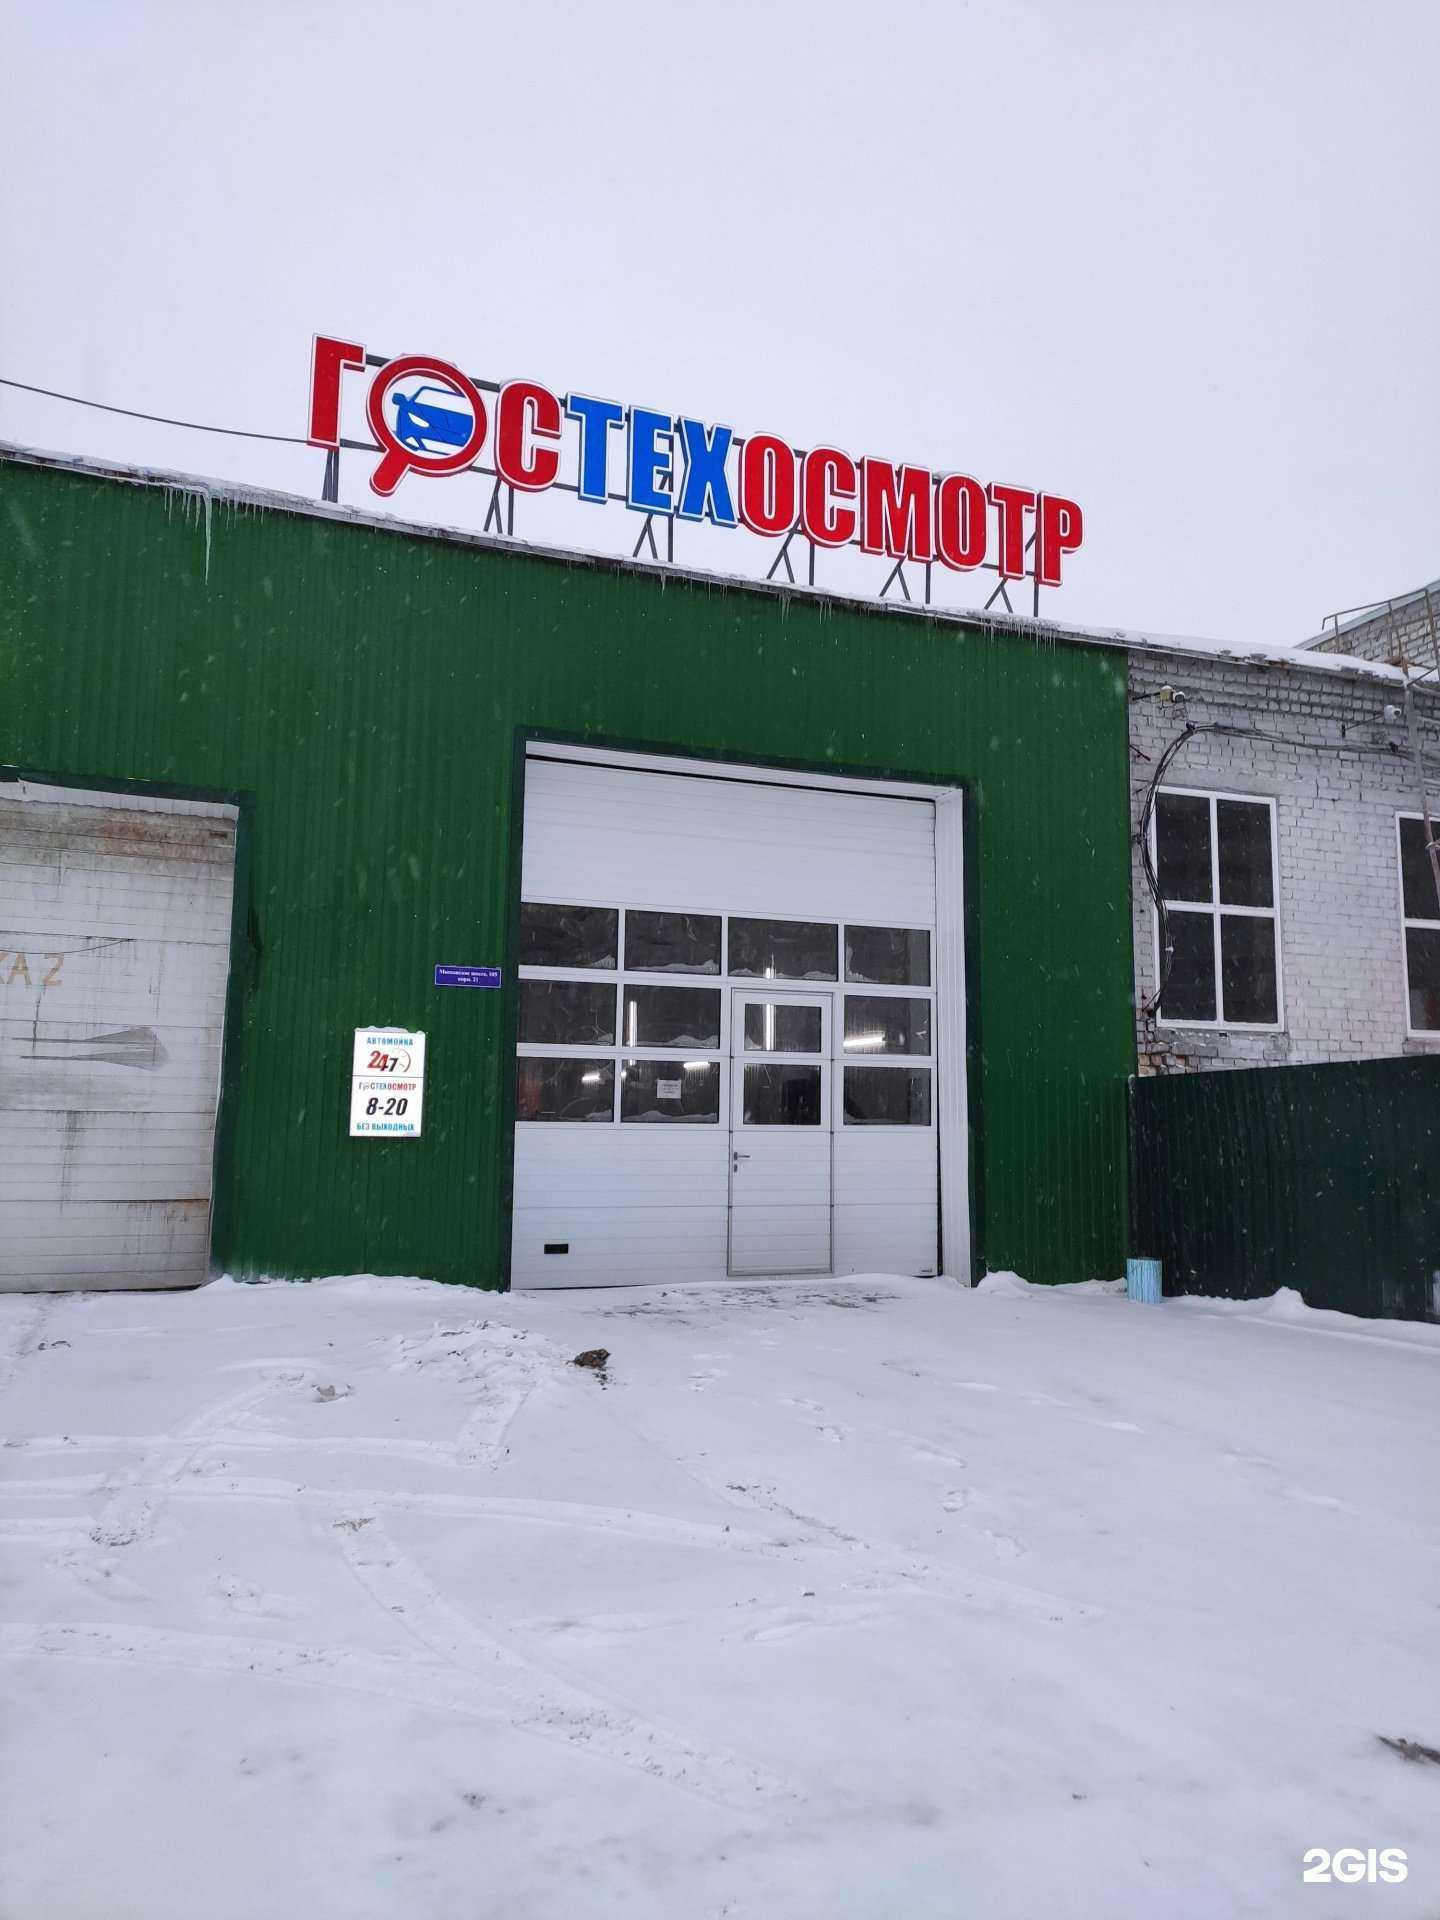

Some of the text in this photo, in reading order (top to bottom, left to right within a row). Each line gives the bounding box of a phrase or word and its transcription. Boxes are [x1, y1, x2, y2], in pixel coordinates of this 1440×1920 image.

[41, 953, 64, 987] 2
[367, 1037, 413, 1046] АВТОМОЙКА
[366, 1097, 408, 1116] 8-20
[356, 1122, 414, 1132] БЕЗ ВЫХОДНЫХ
